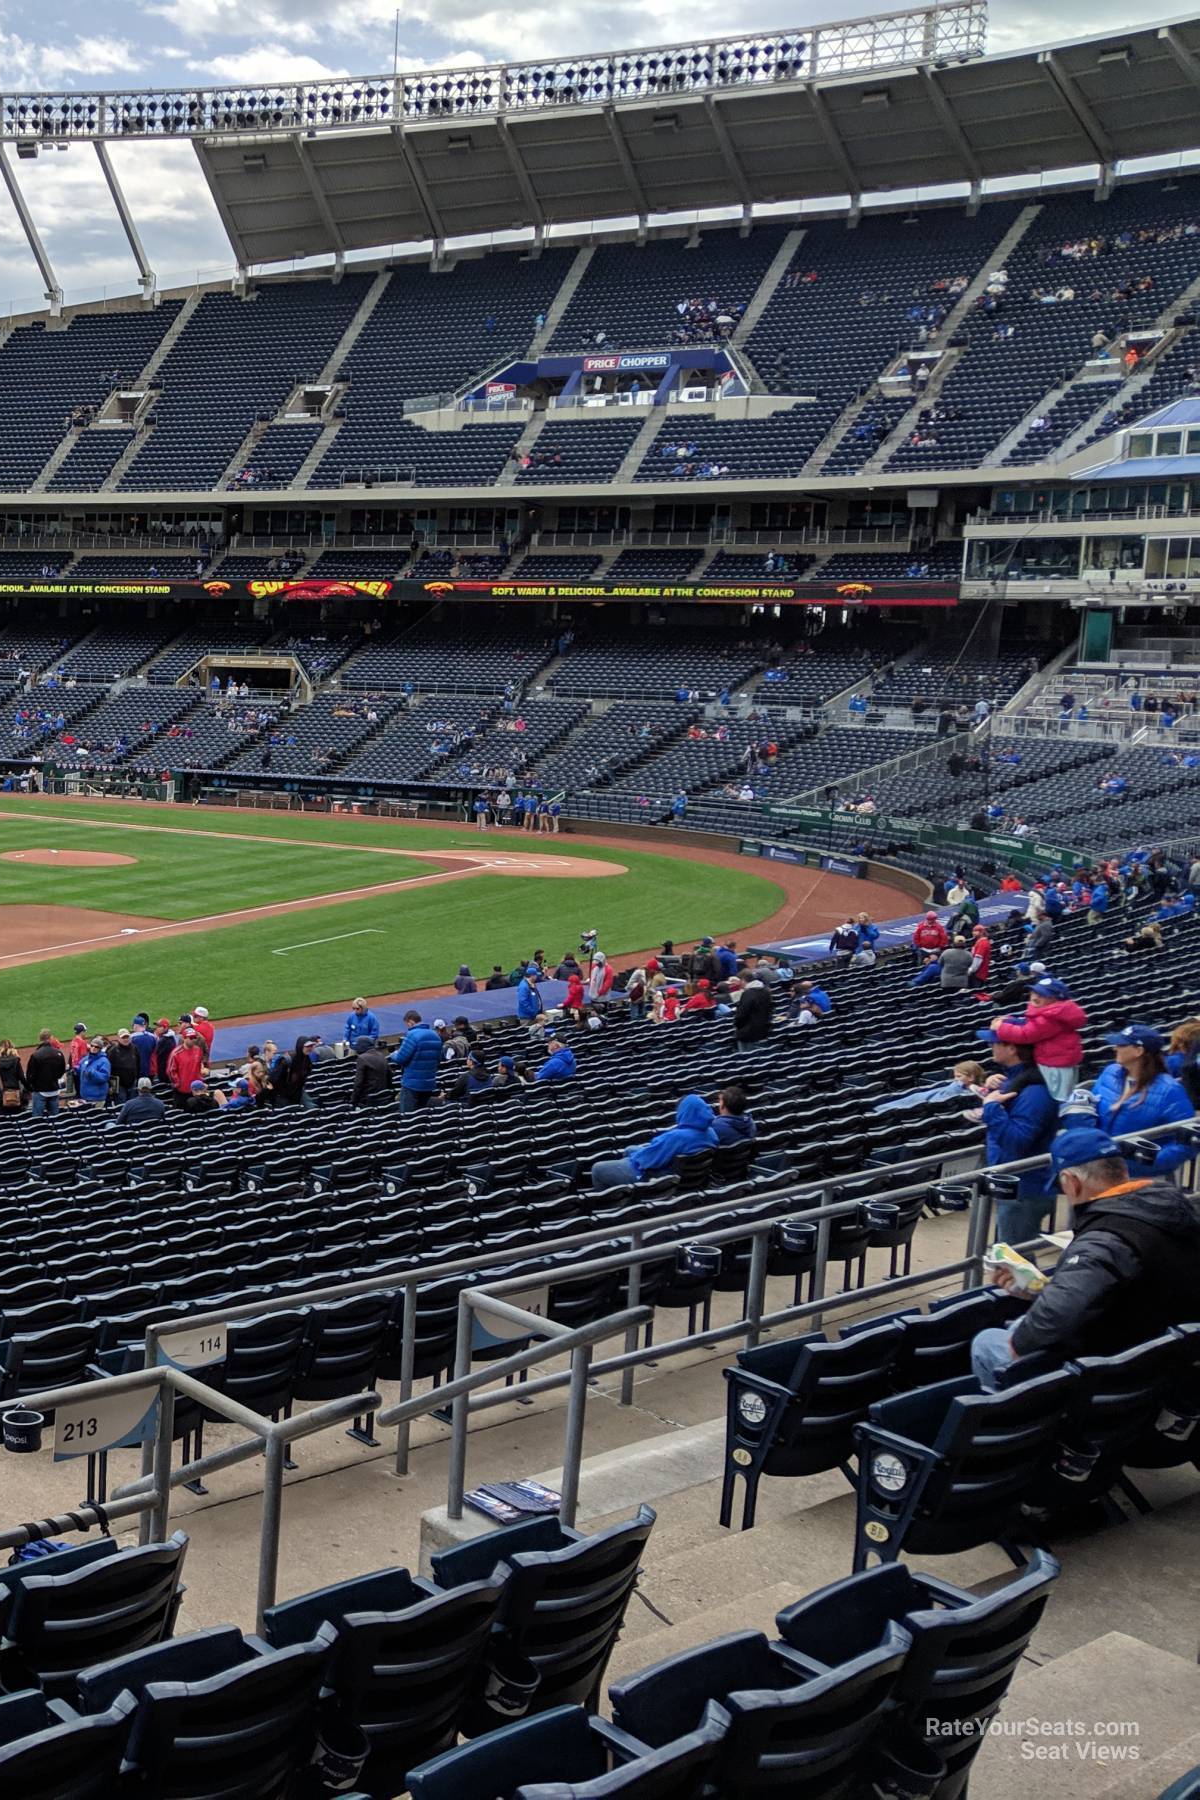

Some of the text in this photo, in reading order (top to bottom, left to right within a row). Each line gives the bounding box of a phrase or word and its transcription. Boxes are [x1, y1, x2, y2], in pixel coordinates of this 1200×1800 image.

[587, 355, 667, 368] PRICE CHOPPER
[69, 585, 79, 593] AT
[663, 588, 676, 597] AT
[696, 589, 760, 597] CONCESSION
[762, 590, 795, 598] STAND
[829, 812, 871, 825] CROWN CLUB
[200, 1337, 221, 1353] 114
[63, 1418, 98, 1442] 213
